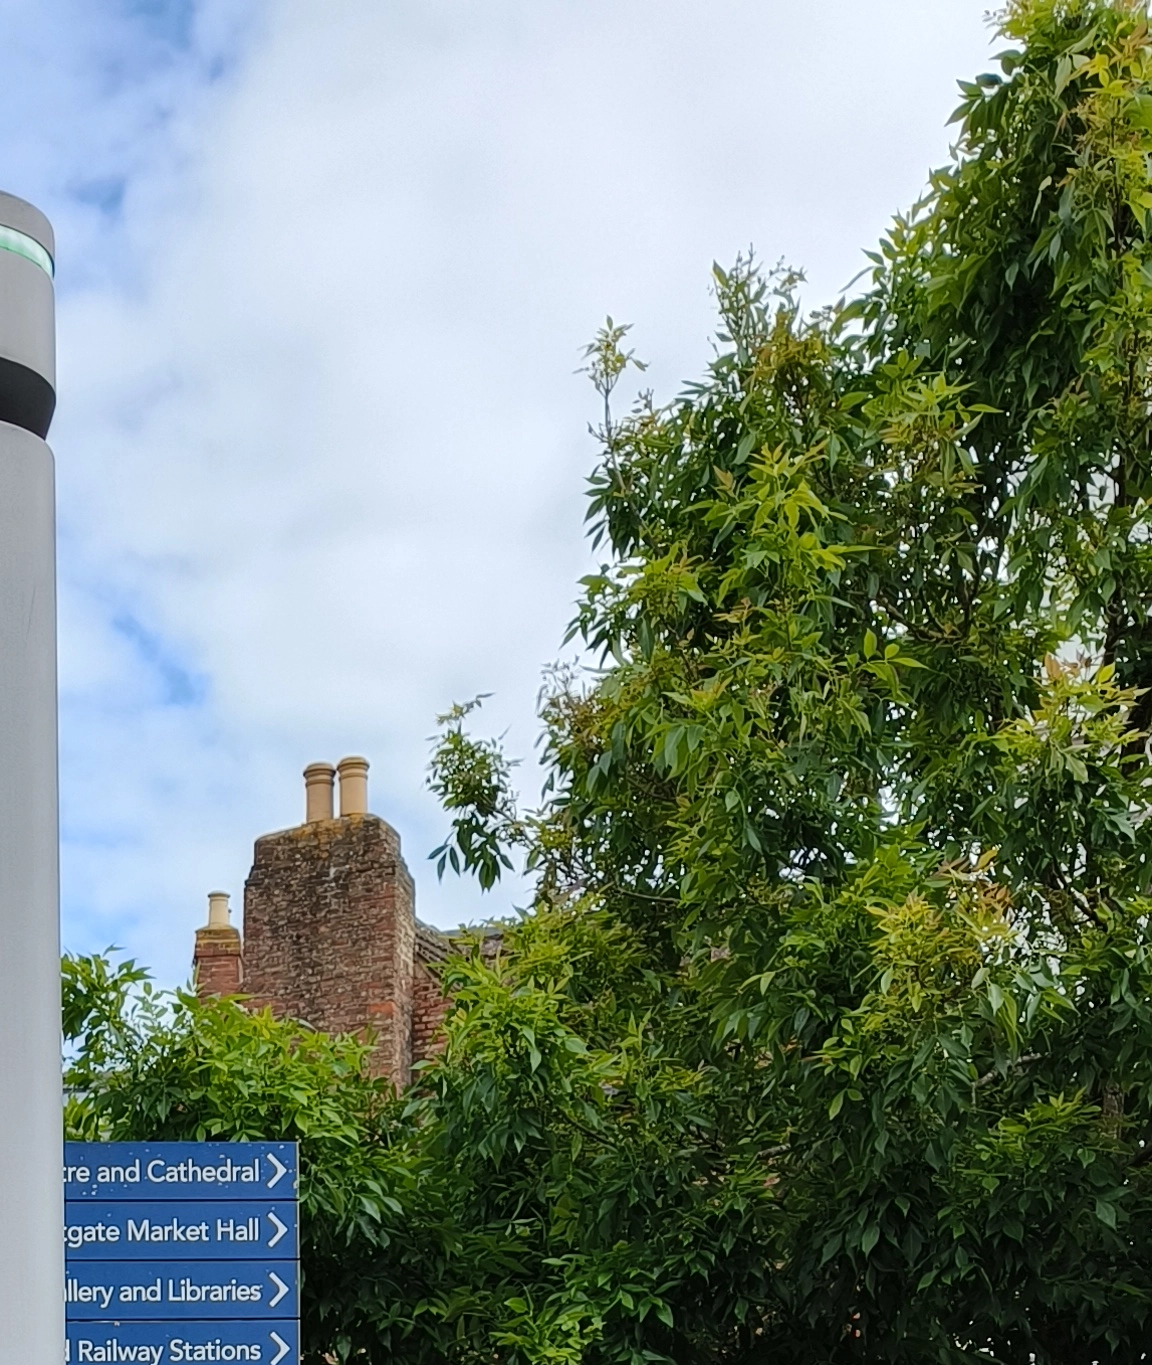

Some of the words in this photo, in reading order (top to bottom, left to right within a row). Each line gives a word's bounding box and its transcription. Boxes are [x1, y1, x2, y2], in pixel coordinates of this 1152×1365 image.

[97, 1159, 141, 1182] and
[147, 1158, 260, 1182] Cathedral
[127, 1217, 209, 1241] Market
[217, 1217, 259, 1241] Hall
[64, 1278, 114, 1308] llery
[119, 1278, 161, 1301] and
[168, 1278, 262, 1301] Libraries
[169, 1338, 262, 1361] Stations
